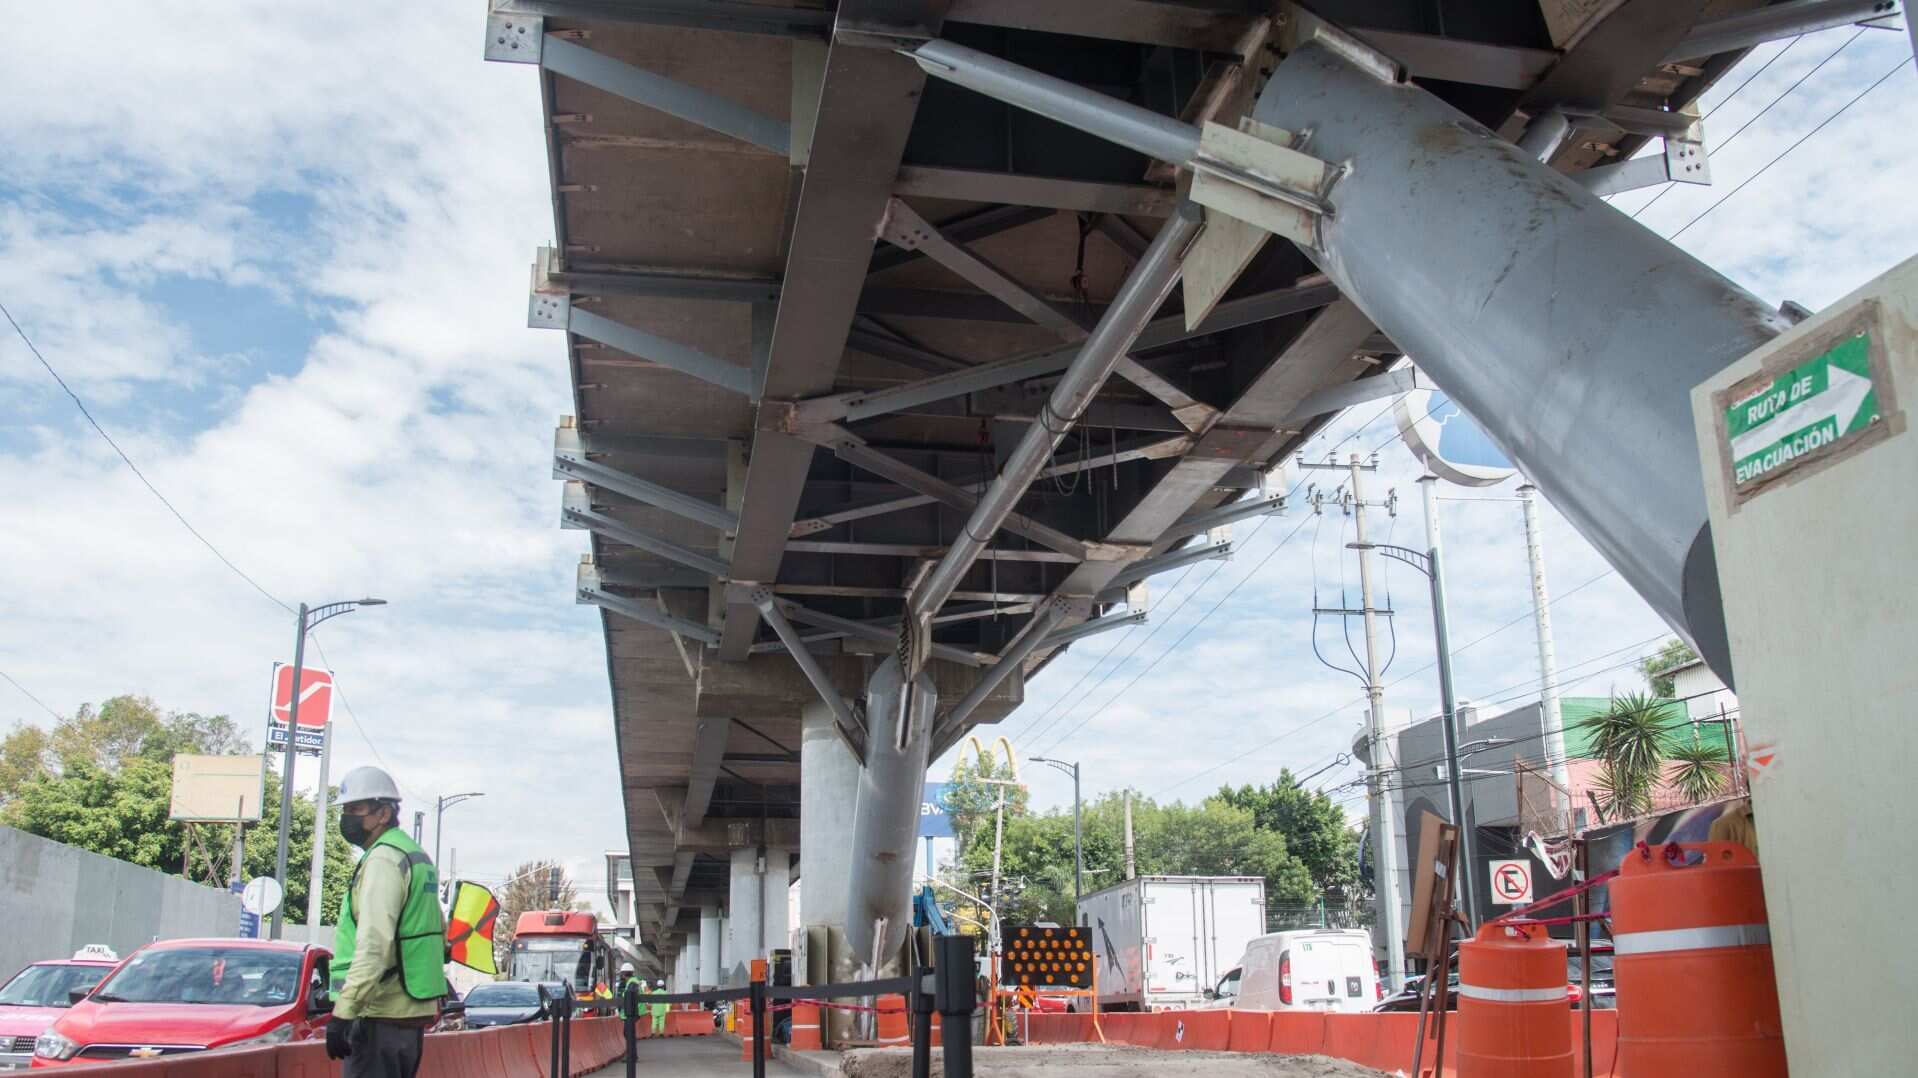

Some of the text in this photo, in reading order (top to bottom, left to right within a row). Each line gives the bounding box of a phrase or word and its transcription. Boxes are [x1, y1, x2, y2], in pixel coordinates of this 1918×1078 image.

[1748, 376, 1813, 425] RUTA DE
[1736, 424, 1835, 485] EVACUACIÓN
